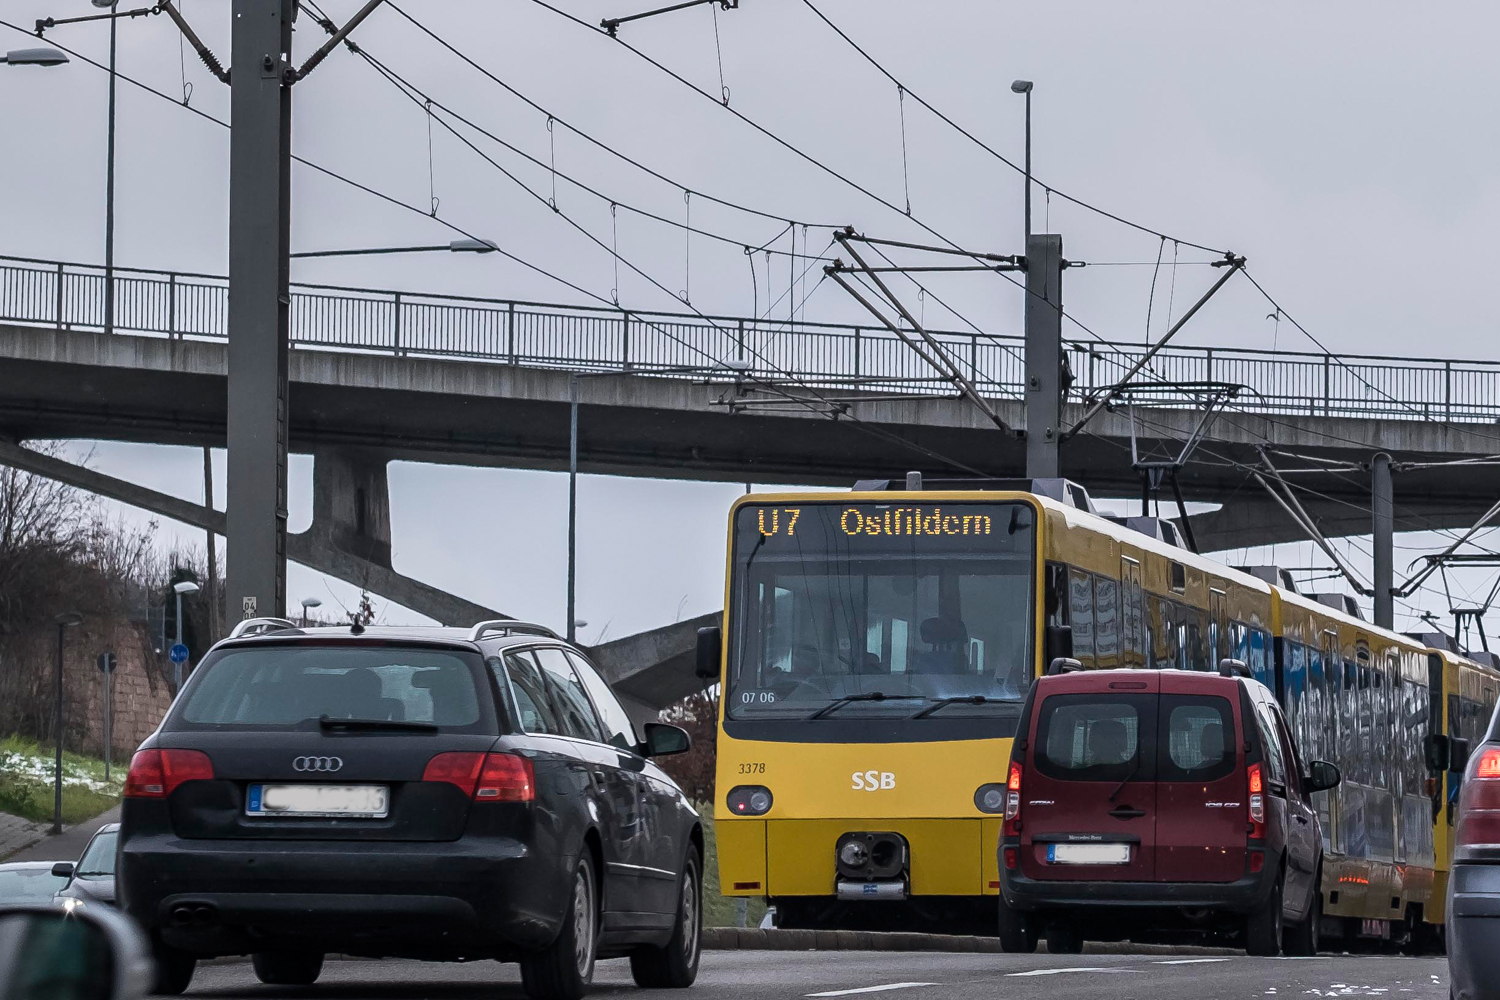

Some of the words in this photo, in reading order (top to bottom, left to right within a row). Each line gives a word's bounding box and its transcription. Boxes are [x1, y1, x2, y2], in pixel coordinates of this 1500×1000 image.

[742, 692, 757, 704] 07
[759, 692, 775, 704] 06
[738, 763, 766, 775] 3378
[851, 770, 896, 792] SSB
